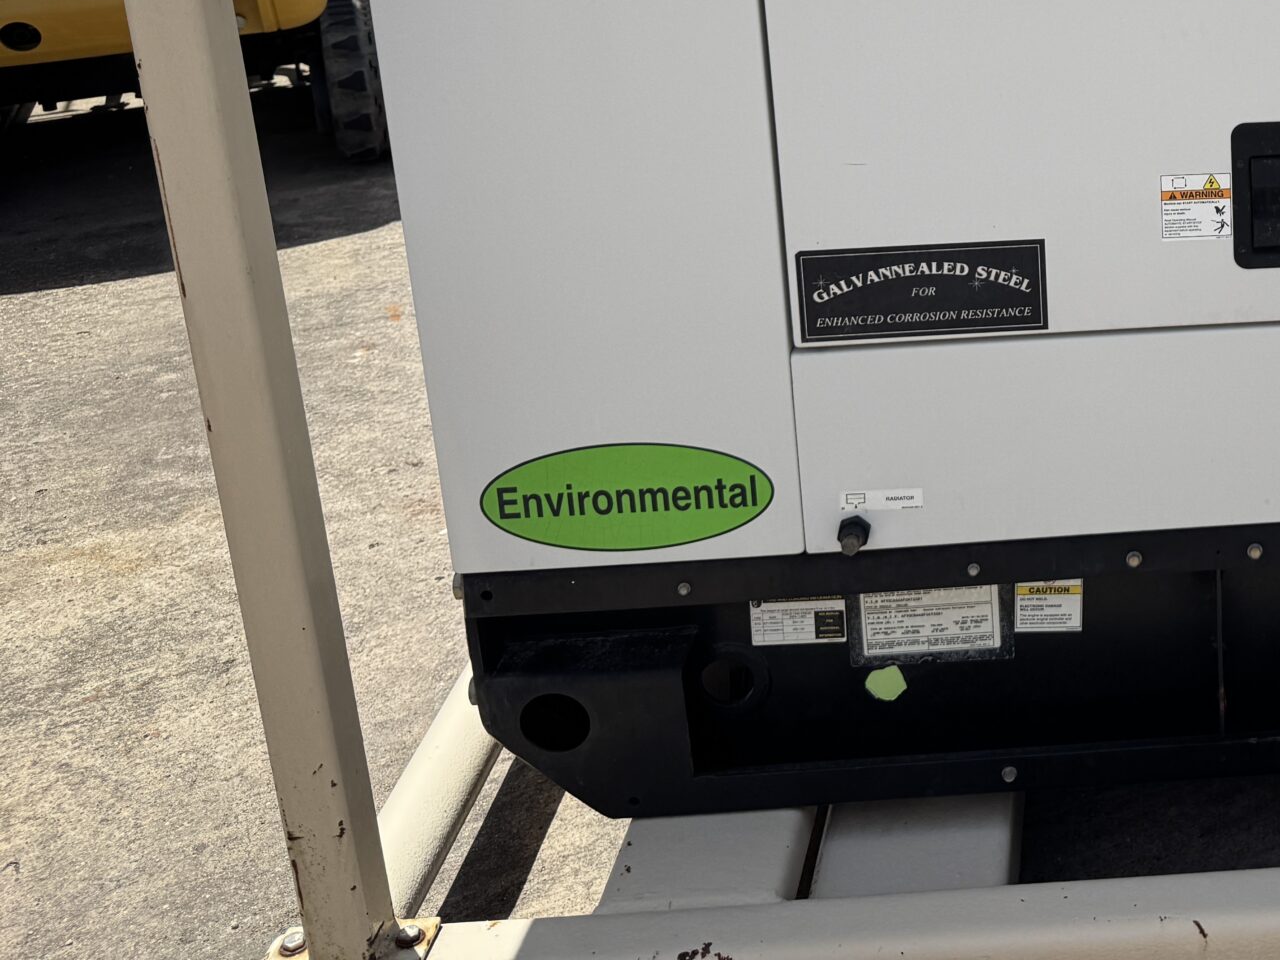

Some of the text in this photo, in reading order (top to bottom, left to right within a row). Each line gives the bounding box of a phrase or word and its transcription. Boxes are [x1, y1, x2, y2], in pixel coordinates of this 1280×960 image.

[1179, 190, 1224, 199] WARNING
[812, 261, 1032, 304] GALVANNEALED STEEL
[911, 286, 936, 297] FOR
[816, 306, 1032, 328] ENHANCED CORROSION RESISTANCE
[496, 474, 758, 520] Environmental
[1028, 586, 1070, 594] CAUTION
